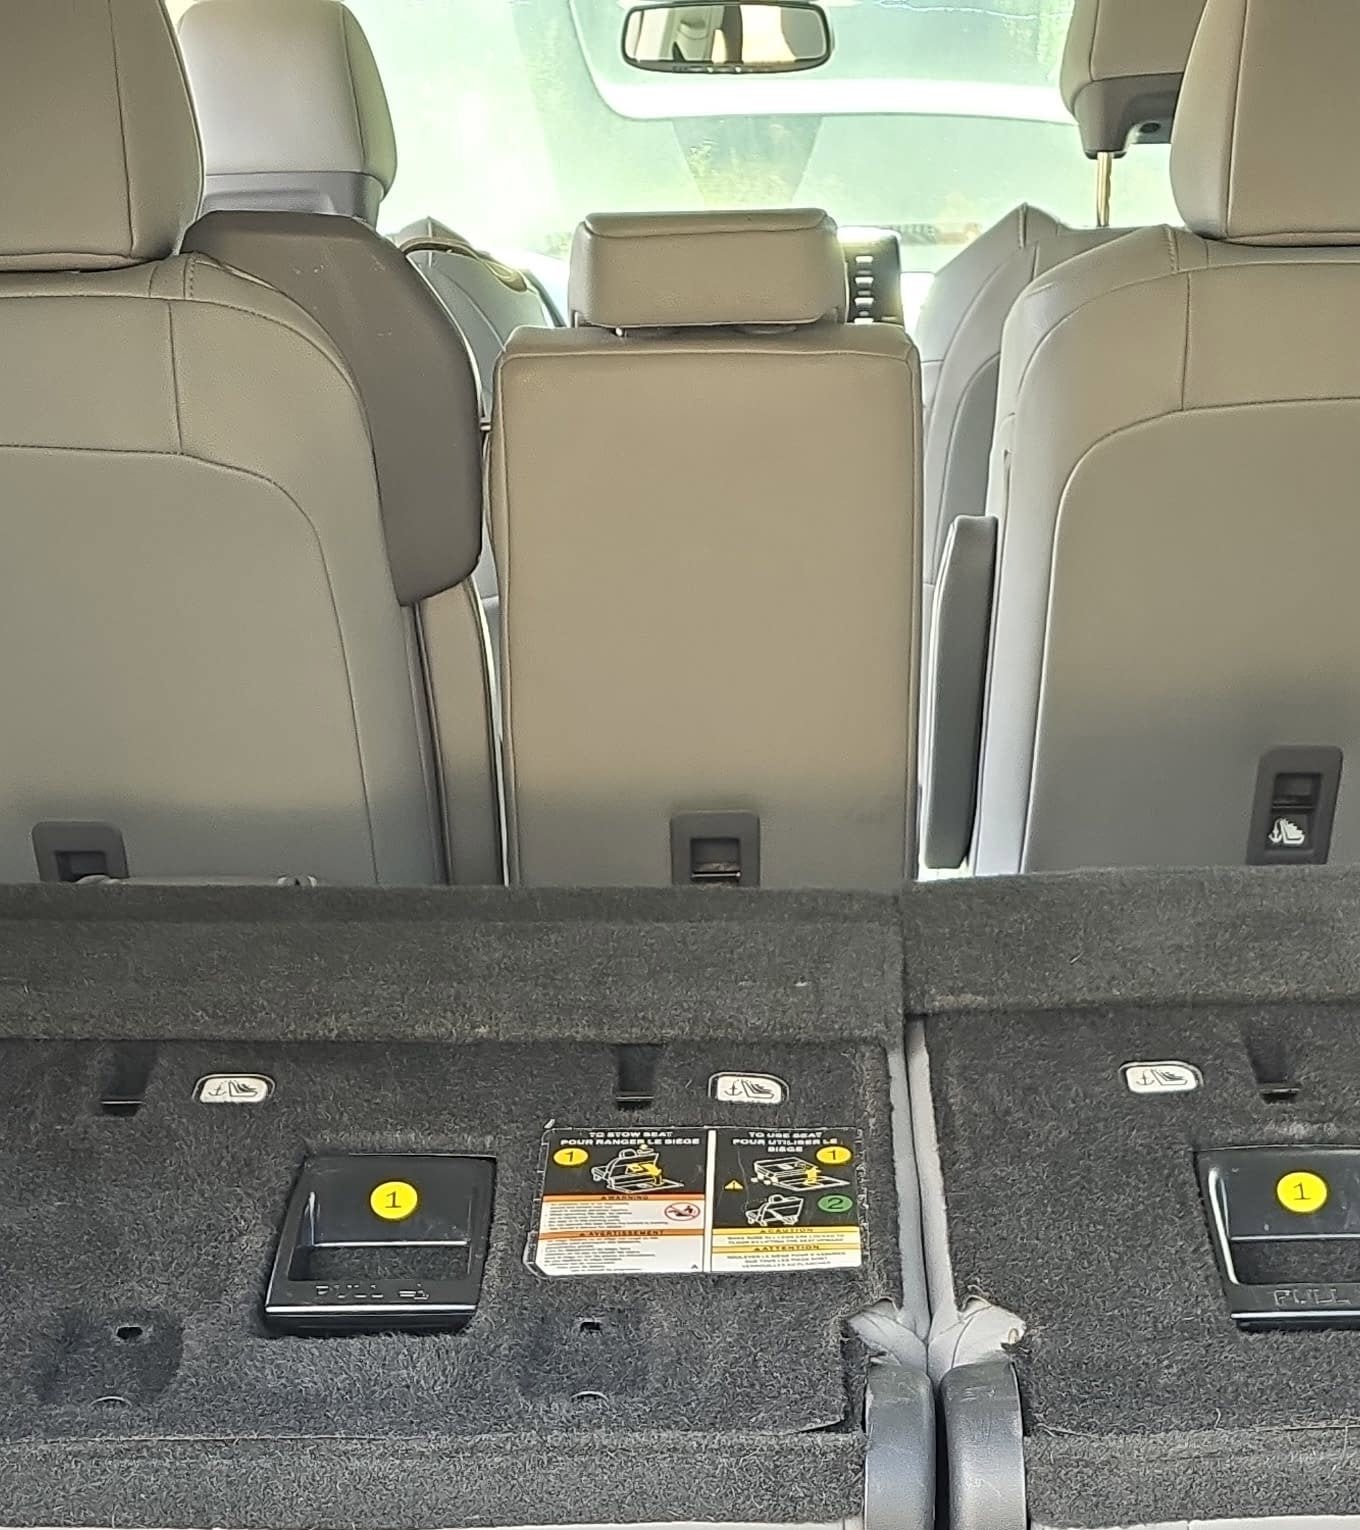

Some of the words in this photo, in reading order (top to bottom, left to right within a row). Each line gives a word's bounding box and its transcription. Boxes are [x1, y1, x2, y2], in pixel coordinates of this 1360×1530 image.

[564, 1152, 574, 1162] 1
[1292, 1182, 1311, 1201] 1
[384, 1191, 402, 1209] 1
[827, 1197, 844, 1209] 2
